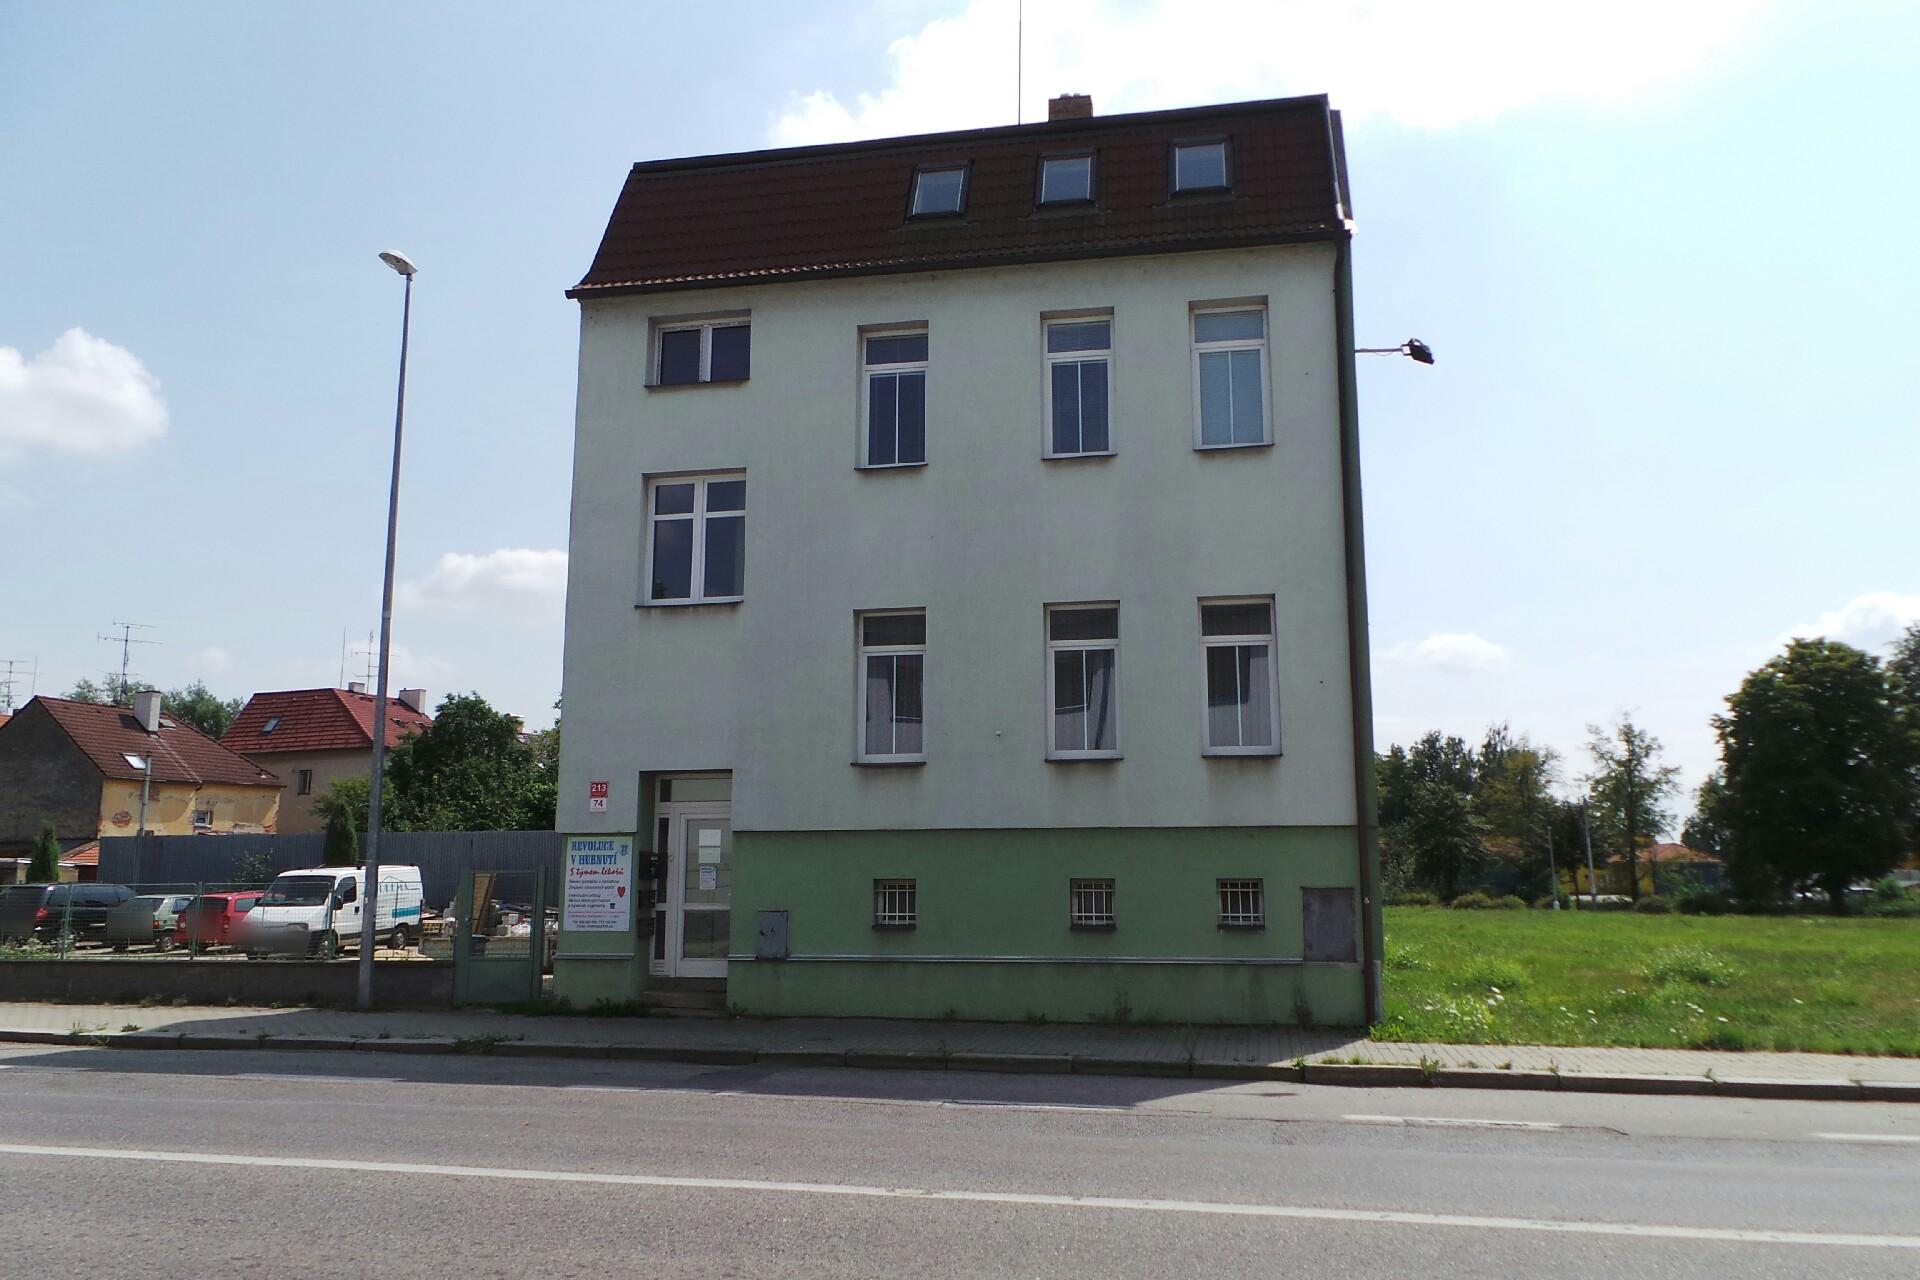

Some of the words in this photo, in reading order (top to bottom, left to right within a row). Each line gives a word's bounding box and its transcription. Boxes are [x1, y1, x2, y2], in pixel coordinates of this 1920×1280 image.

[592, 783, 606, 792] 213
[593, 799, 603, 807] 74
[571, 840, 615, 851] REVOLUCE
[570, 855, 577, 865] V
[578, 852, 617, 865] HUBNUTÍ
